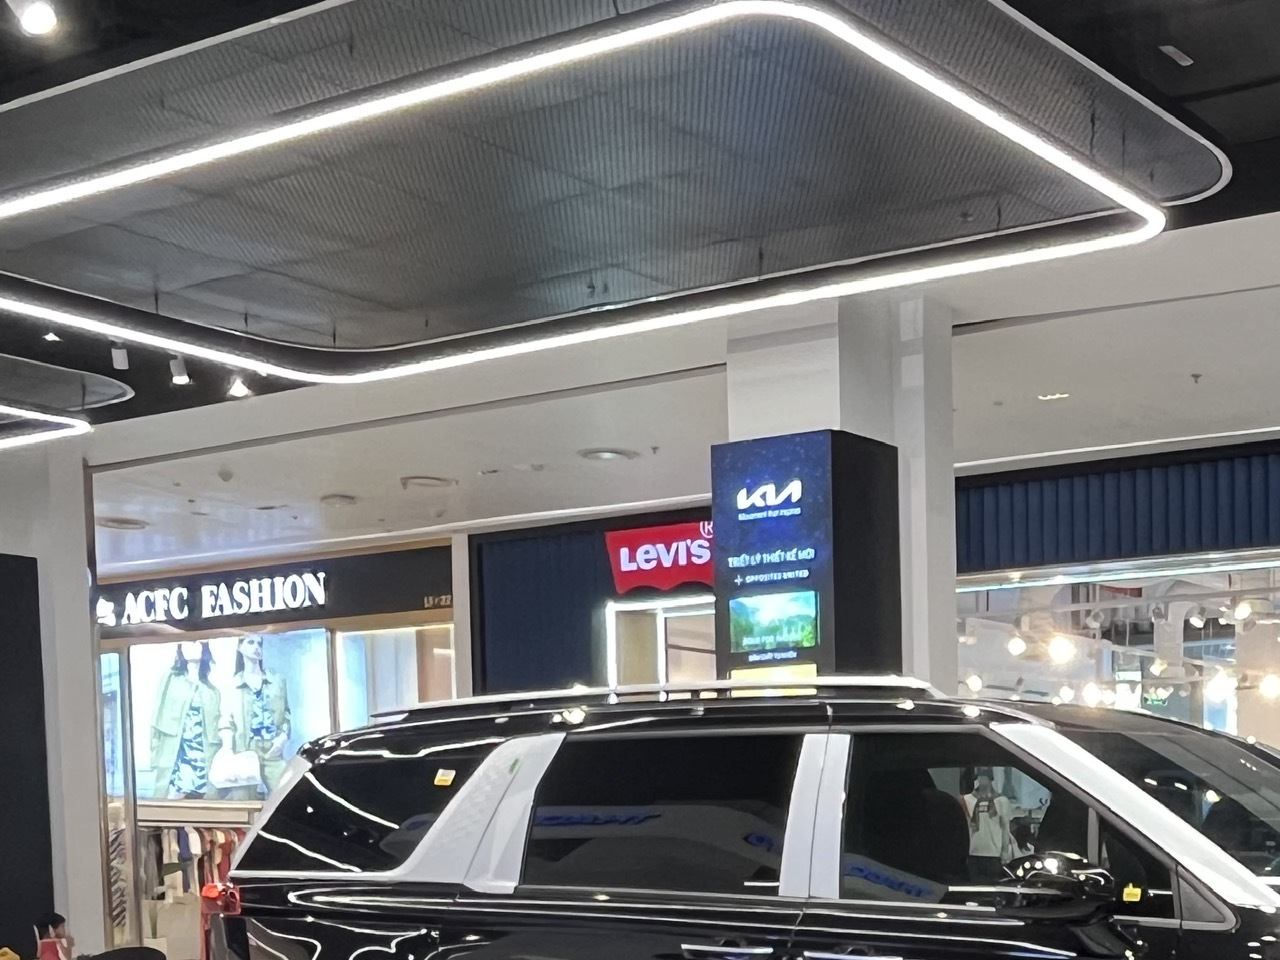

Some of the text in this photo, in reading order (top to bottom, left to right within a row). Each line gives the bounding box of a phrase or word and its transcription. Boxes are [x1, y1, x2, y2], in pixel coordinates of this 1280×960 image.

[736, 479, 802, 510] KIA
[121, 587, 189, 625] ACFC
[201, 571, 326, 619] FASHION
